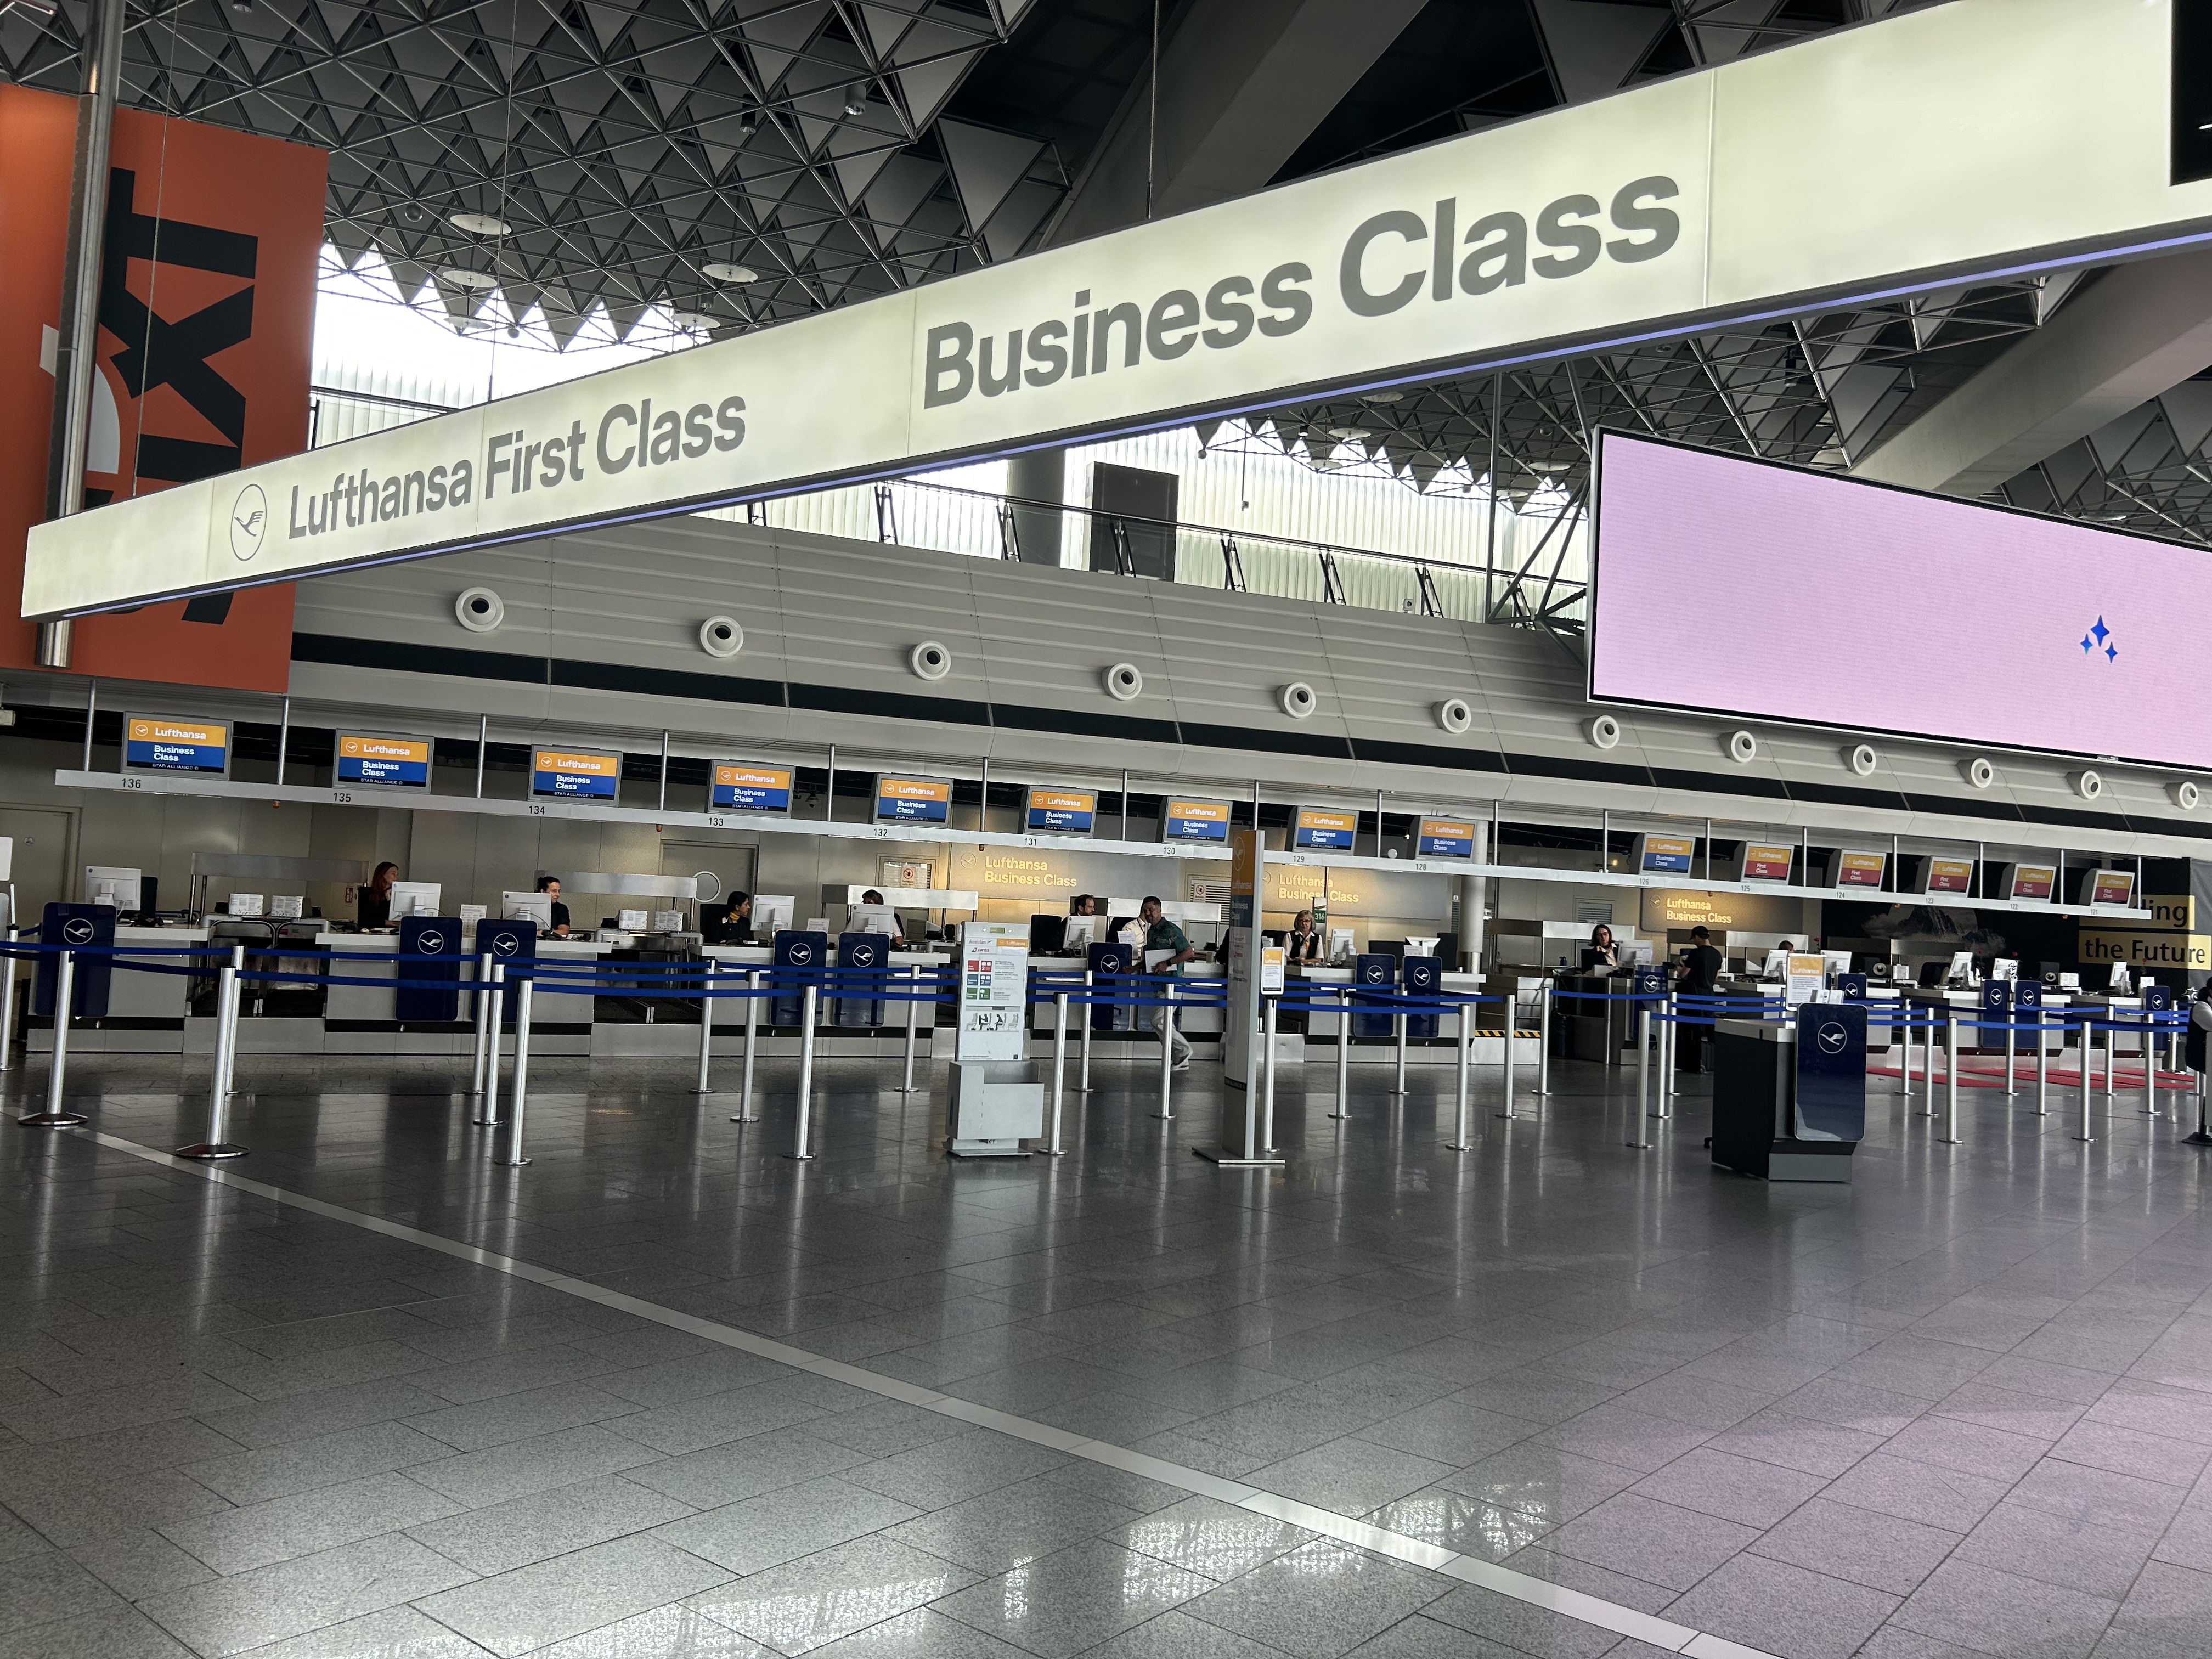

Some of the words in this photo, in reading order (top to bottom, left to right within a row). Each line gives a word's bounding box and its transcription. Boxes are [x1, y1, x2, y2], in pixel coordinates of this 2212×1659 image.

[923, 261, 1313, 410] Business
[1339, 175, 1680, 317] Class
[289, 459, 472, 539] Lufthansa
[485, 420, 586, 500] First
[596, 395, 746, 475] Class
[155, 727, 206, 740] Lufthansa
[154, 745, 195, 755] Business
[363, 744, 410, 755] Lufthansa
[153, 753, 179, 761] Class
[363, 760, 399, 770] Business
[557, 759, 601, 770] Lufthansa
[122, 778, 142, 788] 136
[556, 775, 590, 784] Business
[735, 773, 775, 783] Lufthansa
[734, 788, 766, 797] Business
[899, 786, 935, 795] Lufthansa
[334, 793, 351, 802] 135
[1047, 798, 1081, 806] Lufthansa
[529, 805, 545, 815] 134
[1185, 808, 1216, 816] Lufthansa
[709, 817, 724, 826] 133
[1314, 817, 1344, 826] Lufthansa
[874, 828, 888, 837] 132
[985, 856, 1048, 871] Lufthansa
[985, 871, 1040, 885] Business
[1043, 873, 1077, 887] Class
[1279, 874, 1333, 888] Lufthansa
[1329, 890, 1359, 902] Class
[1667, 898, 1711, 910] Lufthansa
[1666, 910, 1706, 922] Business
[1708, 913, 1732, 923] Class
[2085, 938, 2123, 959] the
[2132, 940, 2205, 963] Future
